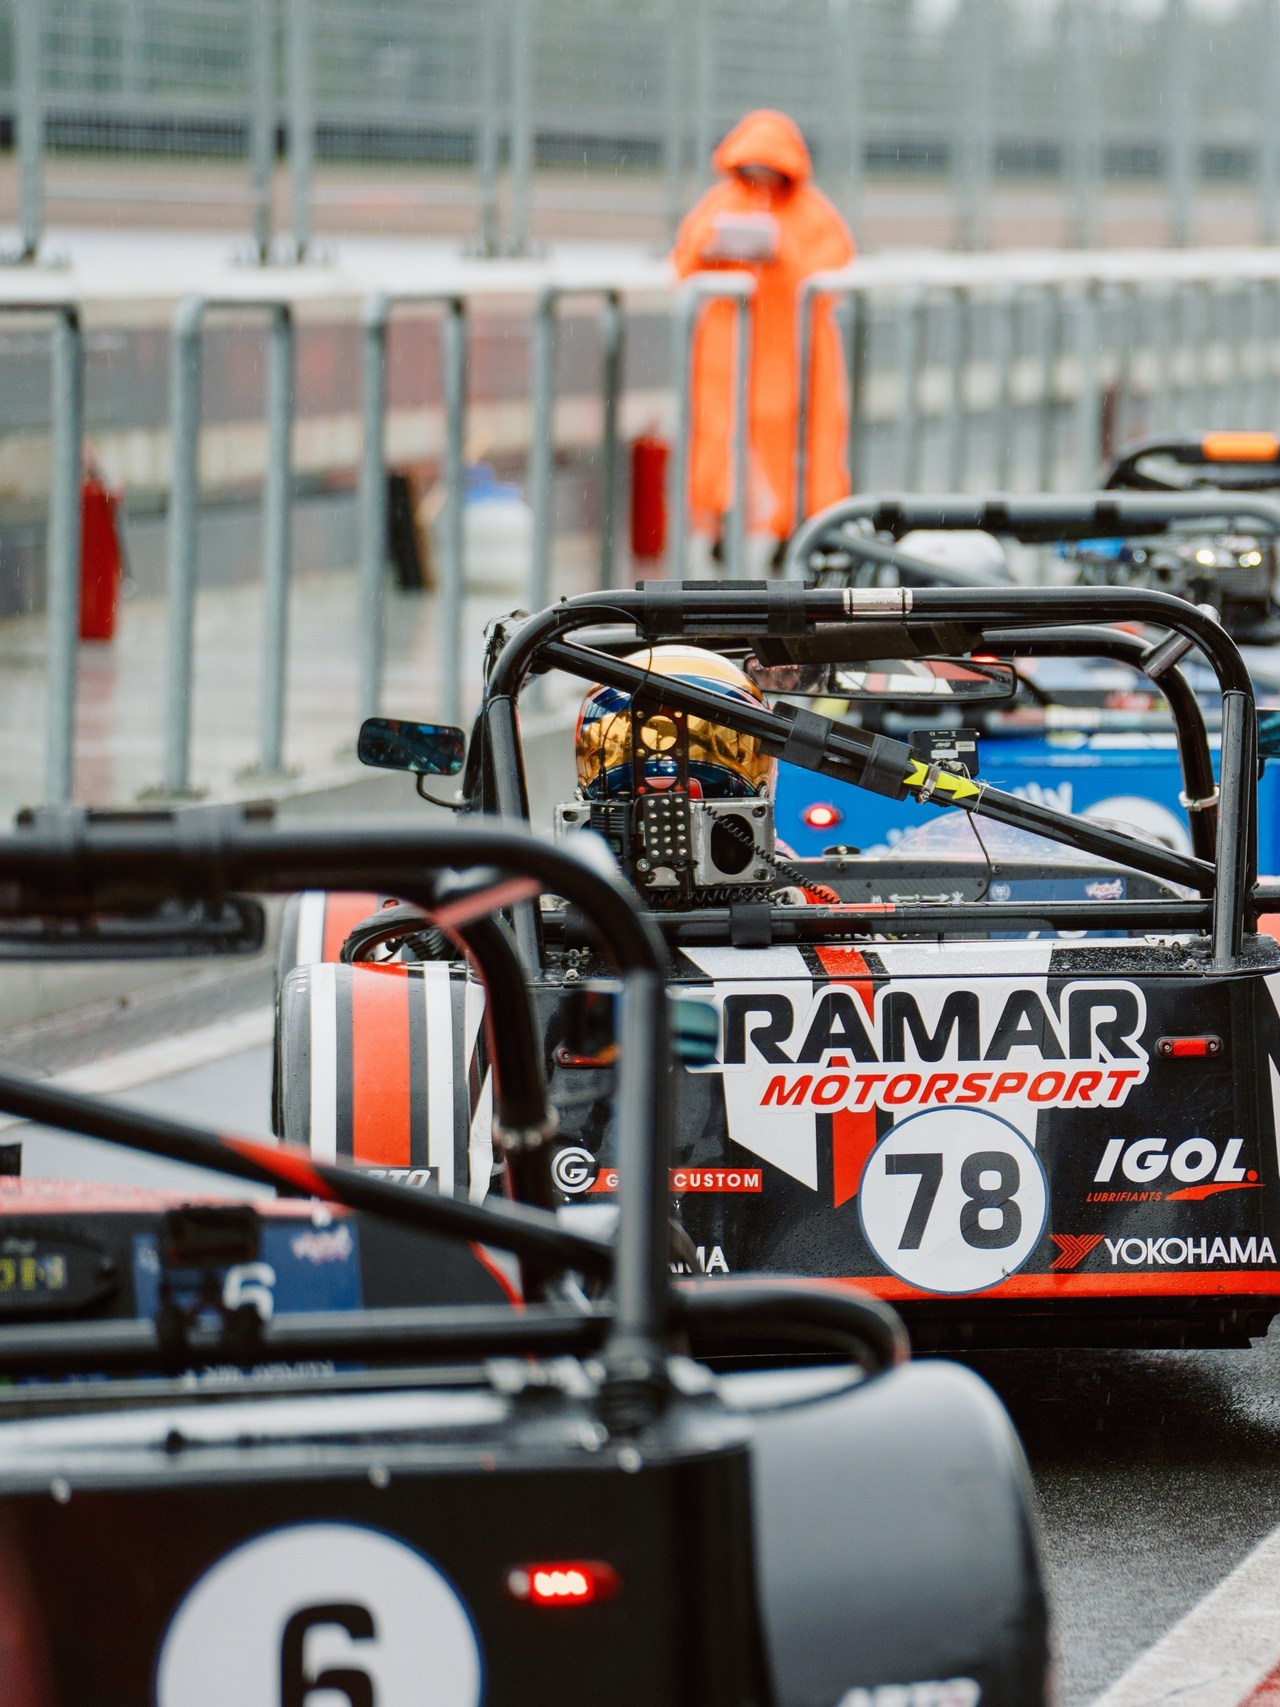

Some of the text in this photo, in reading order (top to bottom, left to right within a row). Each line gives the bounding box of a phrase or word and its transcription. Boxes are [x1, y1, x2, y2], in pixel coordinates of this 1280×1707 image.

[714, 990, 1140, 1064] RAMAR
[760, 1069, 1140, 1106] MOTORSPORT
[673, 1173, 759, 1187] CUSTOM
[1086, 1191, 1162, 1203] LUBRIFIANTS
[885, 1151, 1022, 1250] 78
[1104, 1236, 1277, 1265] YOKOHAMA
[279, 1602, 378, 1707] 6
